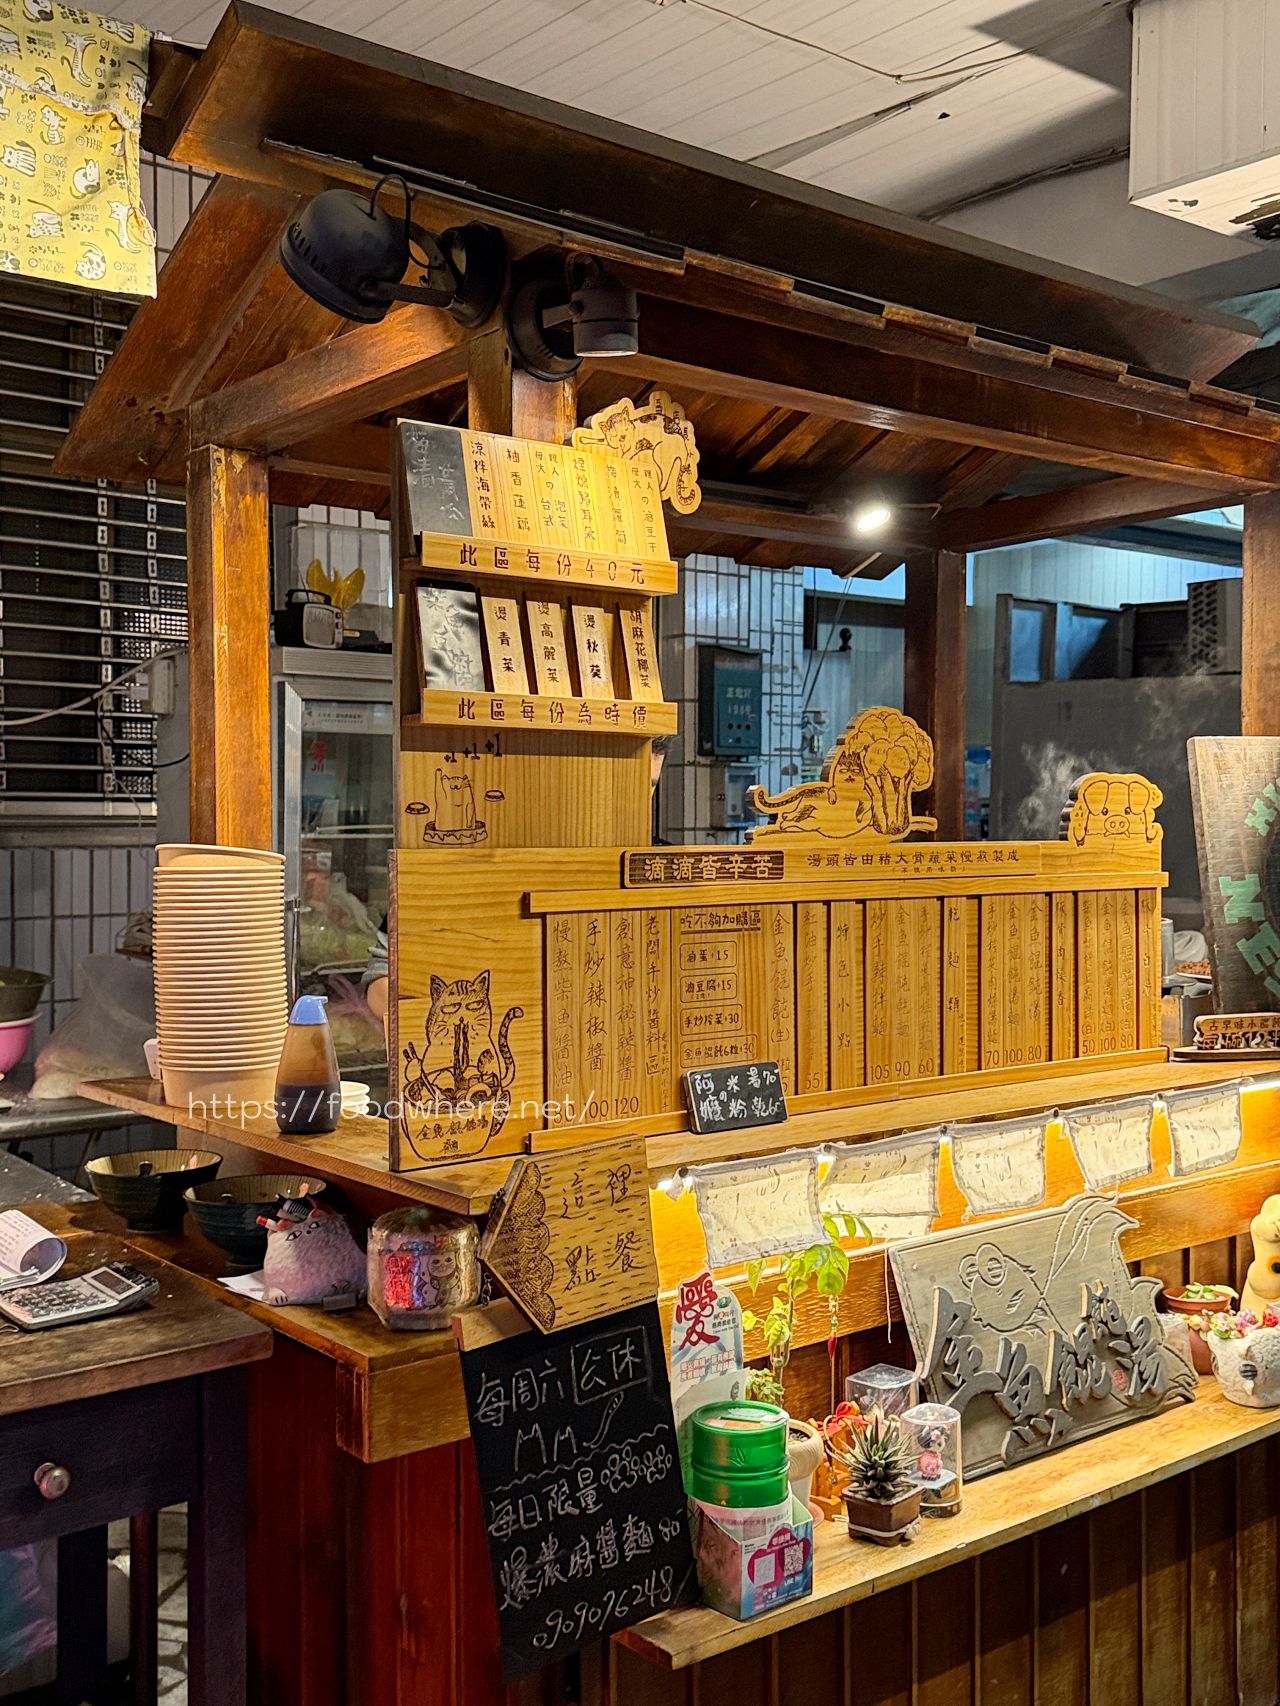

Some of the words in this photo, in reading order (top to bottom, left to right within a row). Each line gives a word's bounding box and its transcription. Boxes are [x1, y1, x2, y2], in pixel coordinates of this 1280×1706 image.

[460, 543, 646, 586] 此區每份40元
[493, 605, 516, 673] 燙青菜
[537, 601, 560, 683] 燙高麗菜
[583, 614, 602, 679] 燙秋葵
[458, 697, 647, 729] 此區每份為時價
[644, 854, 773, 881] 滴滴皆辛苦
[680, 909, 761, 929] 吃不夠加購區
[584, 918, 607, 1071] 手炒辣椒醬
[1082, 1039, 1096, 1055] 50
[1100, 1037, 1117, 1052] 100
[1120, 1034, 1134, 1050] 80
[986, 1050, 1000, 1067] 70
[1005, 1048, 1023, 1065] 100
[1028, 1045, 1042, 1062] 80
[870, 1063, 890, 1081] 105
[895, 1060, 911, 1077] 90
[918, 1057, 934, 1074] 60
[615, 1096, 639, 1116] 120
[563, 1230, 645, 1293] 點餐
[488, 1466, 604, 1542] 每日限量
